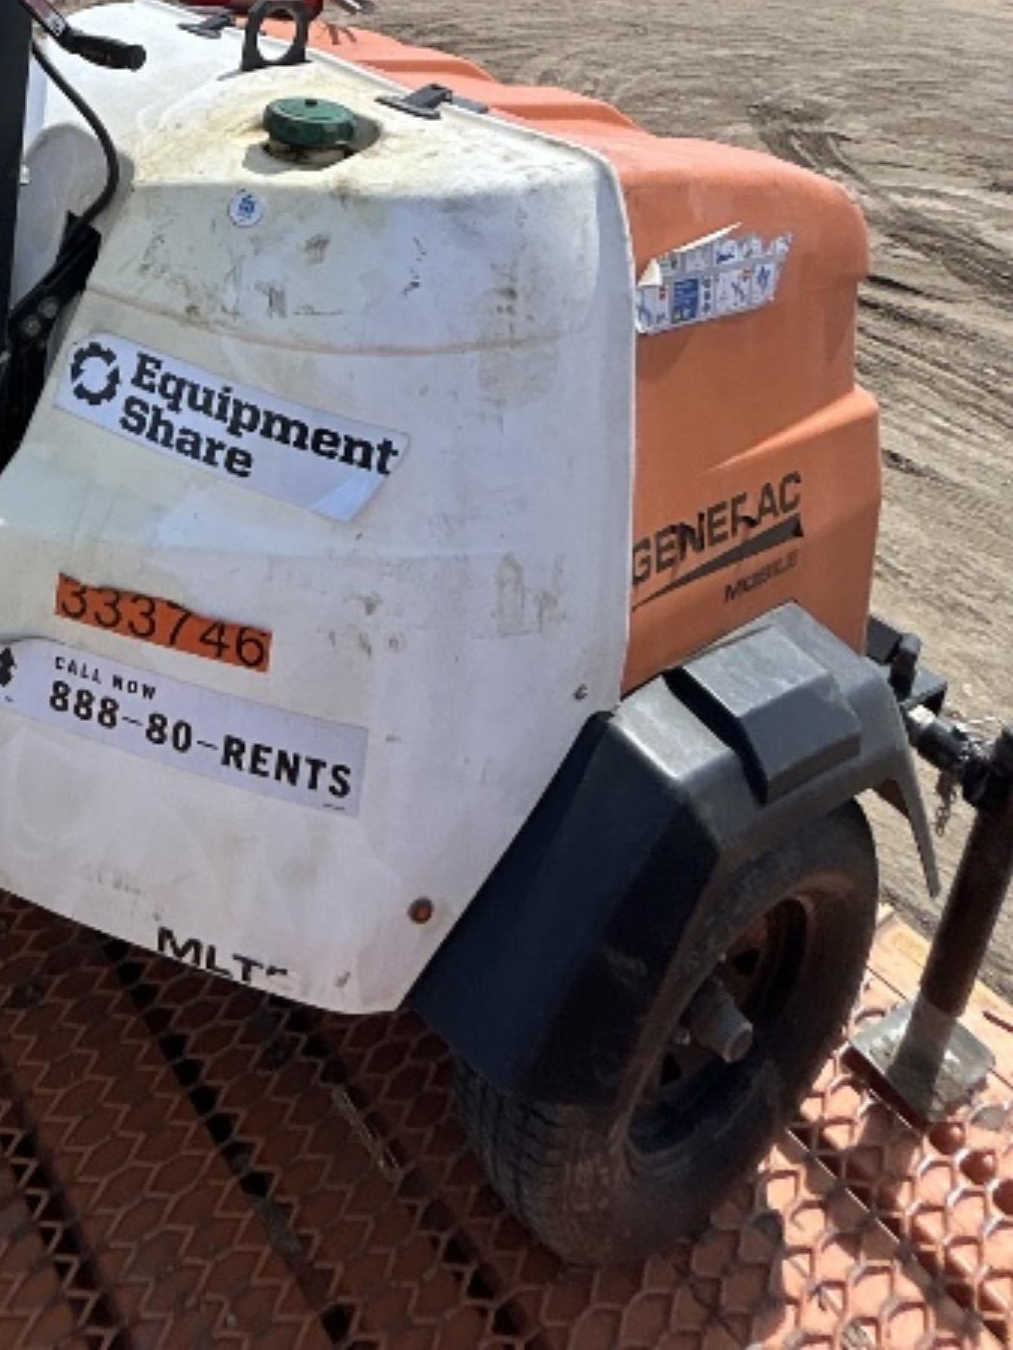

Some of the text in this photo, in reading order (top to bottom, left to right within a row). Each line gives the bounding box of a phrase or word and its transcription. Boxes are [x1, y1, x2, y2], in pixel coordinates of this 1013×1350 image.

[119, 395, 254, 478] Share
[130, 353, 400, 475] Equipment
[61, 576, 269, 668] 333746
[55, 656, 156, 700] CALL NOW
[49, 680, 351, 798] 888-80-RENTS
[157, 926, 287, 984] MLT
